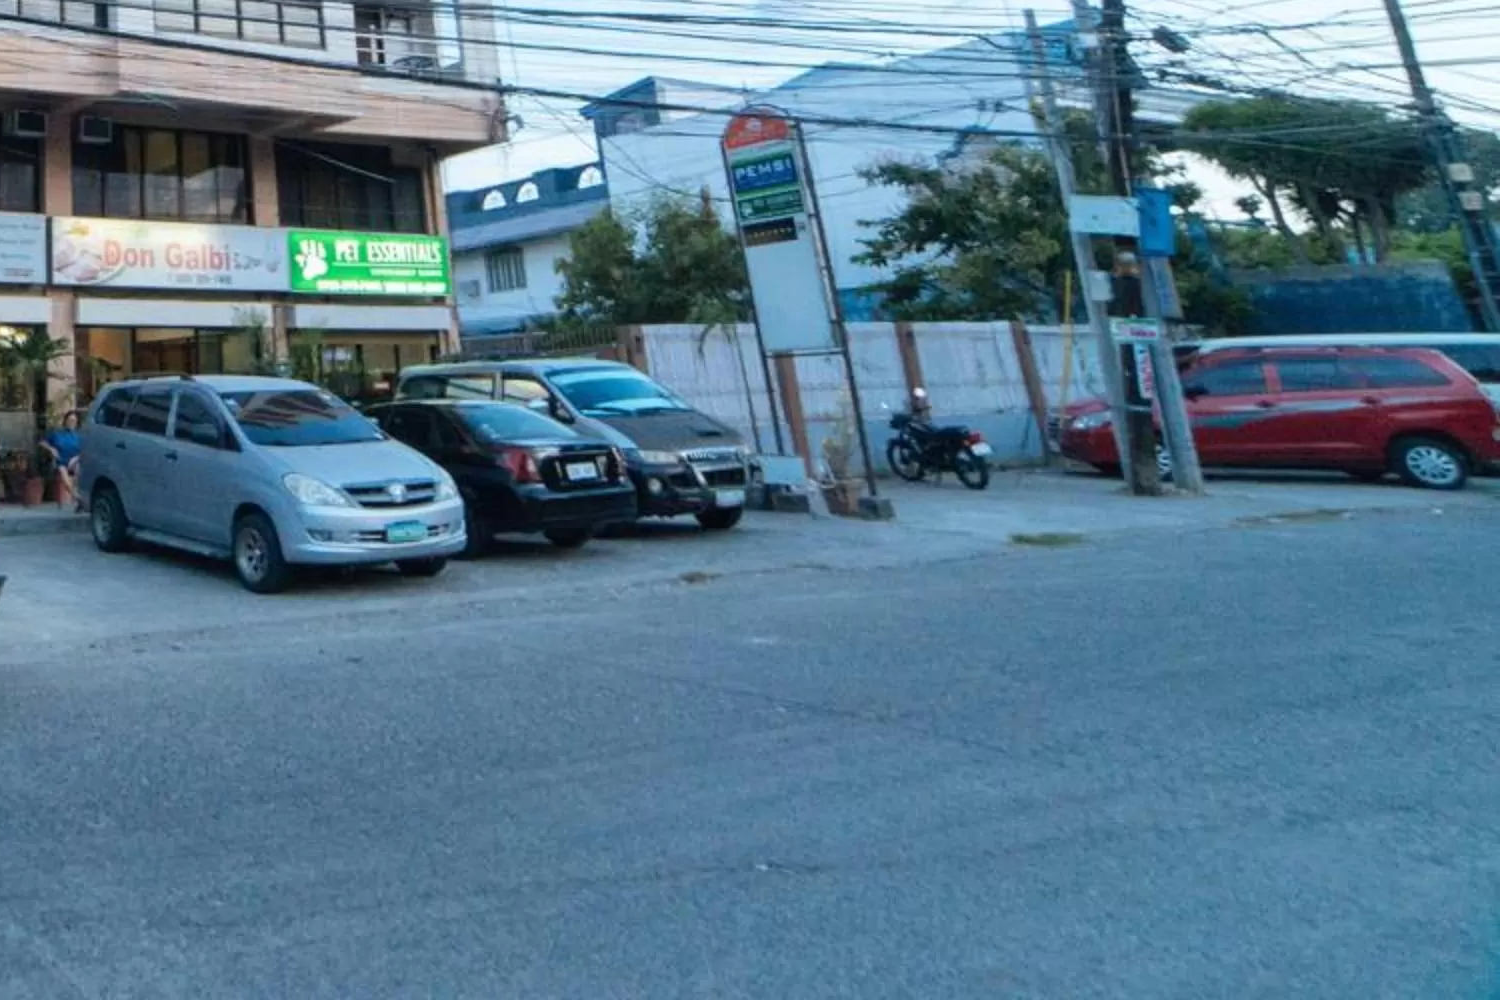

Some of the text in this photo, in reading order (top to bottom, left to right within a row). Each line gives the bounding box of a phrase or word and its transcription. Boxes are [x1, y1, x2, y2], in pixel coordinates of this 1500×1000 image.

[103, 240, 231, 270] Don Galbi
[334, 240, 441, 263] PET ESSENTIALS
